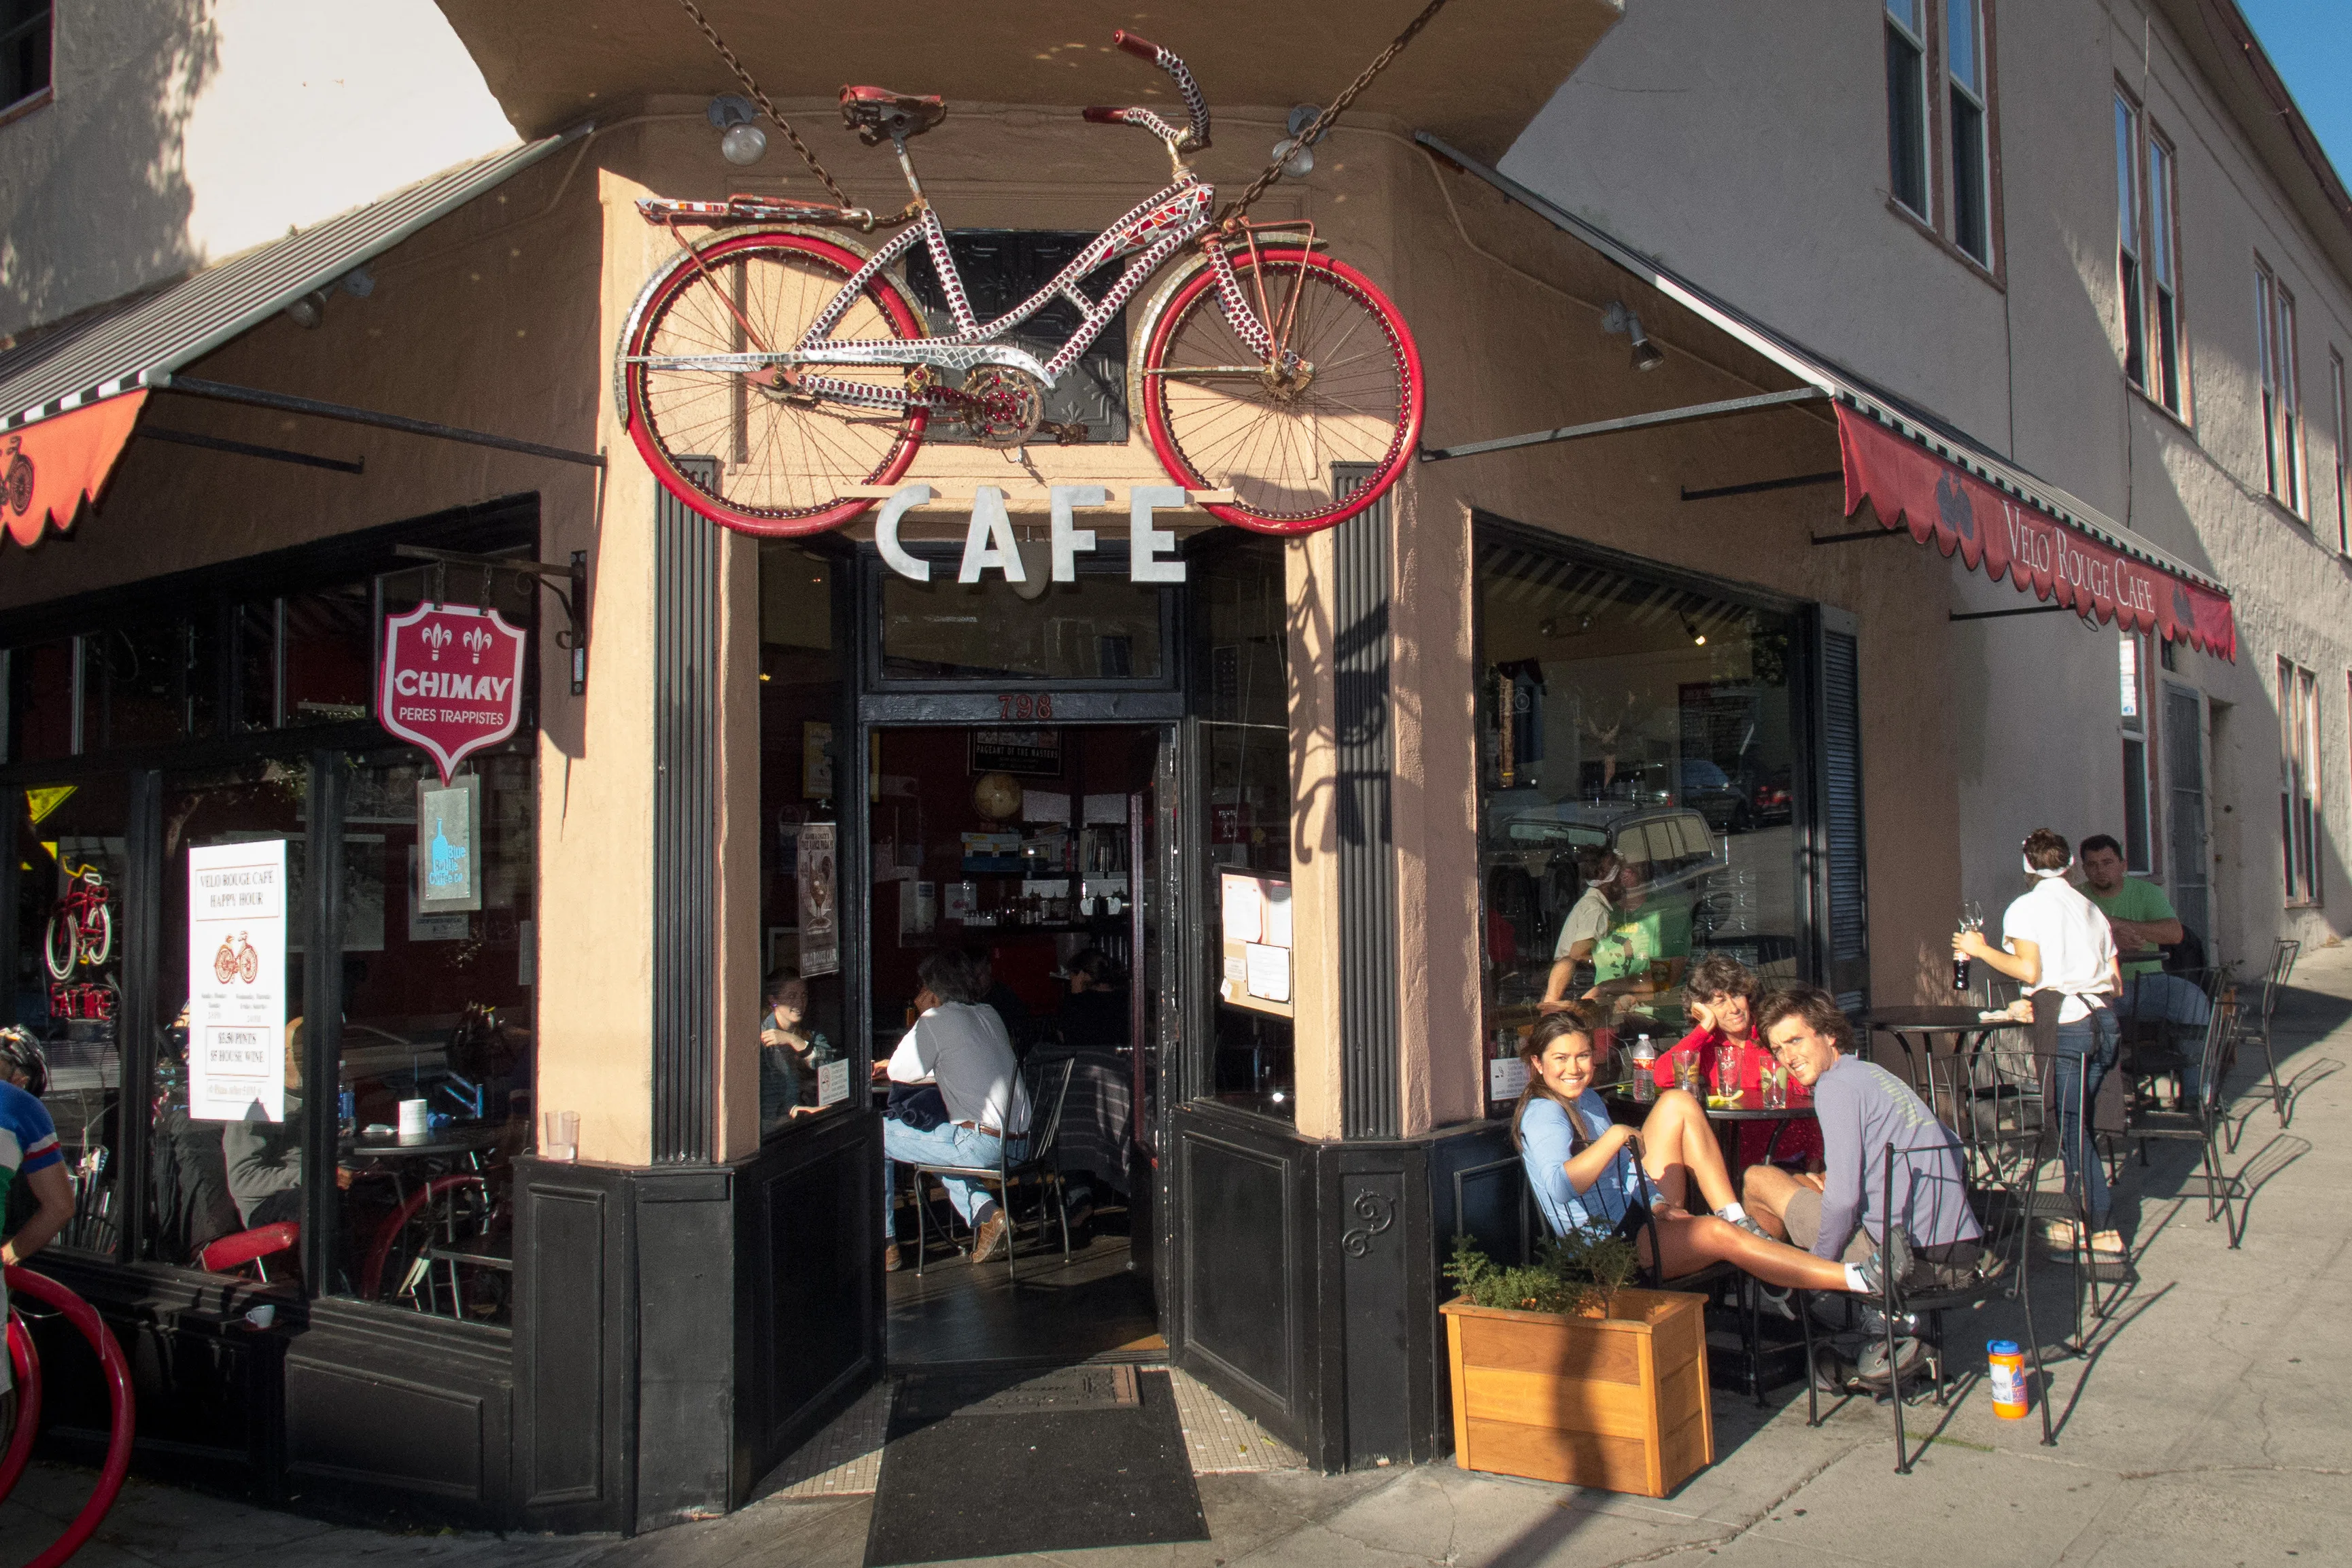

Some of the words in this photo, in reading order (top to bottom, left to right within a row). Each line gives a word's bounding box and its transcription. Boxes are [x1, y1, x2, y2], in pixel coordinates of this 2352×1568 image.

[875, 484, 1187, 583] CAFE
[2003, 500, 2050, 572] VELO
[2055, 527, 2110, 600] ROUGE
[2115, 557, 2154, 613] CAFE
[394, 668, 513, 702] CHIMAY
[399, 706, 437, 722] PERES
[440, 709, 504, 725] TRAPPISTES
[998, 693, 1052, 720] 798
[447, 845, 467, 860] Blue
[50, 982, 77, 1018] FAT
